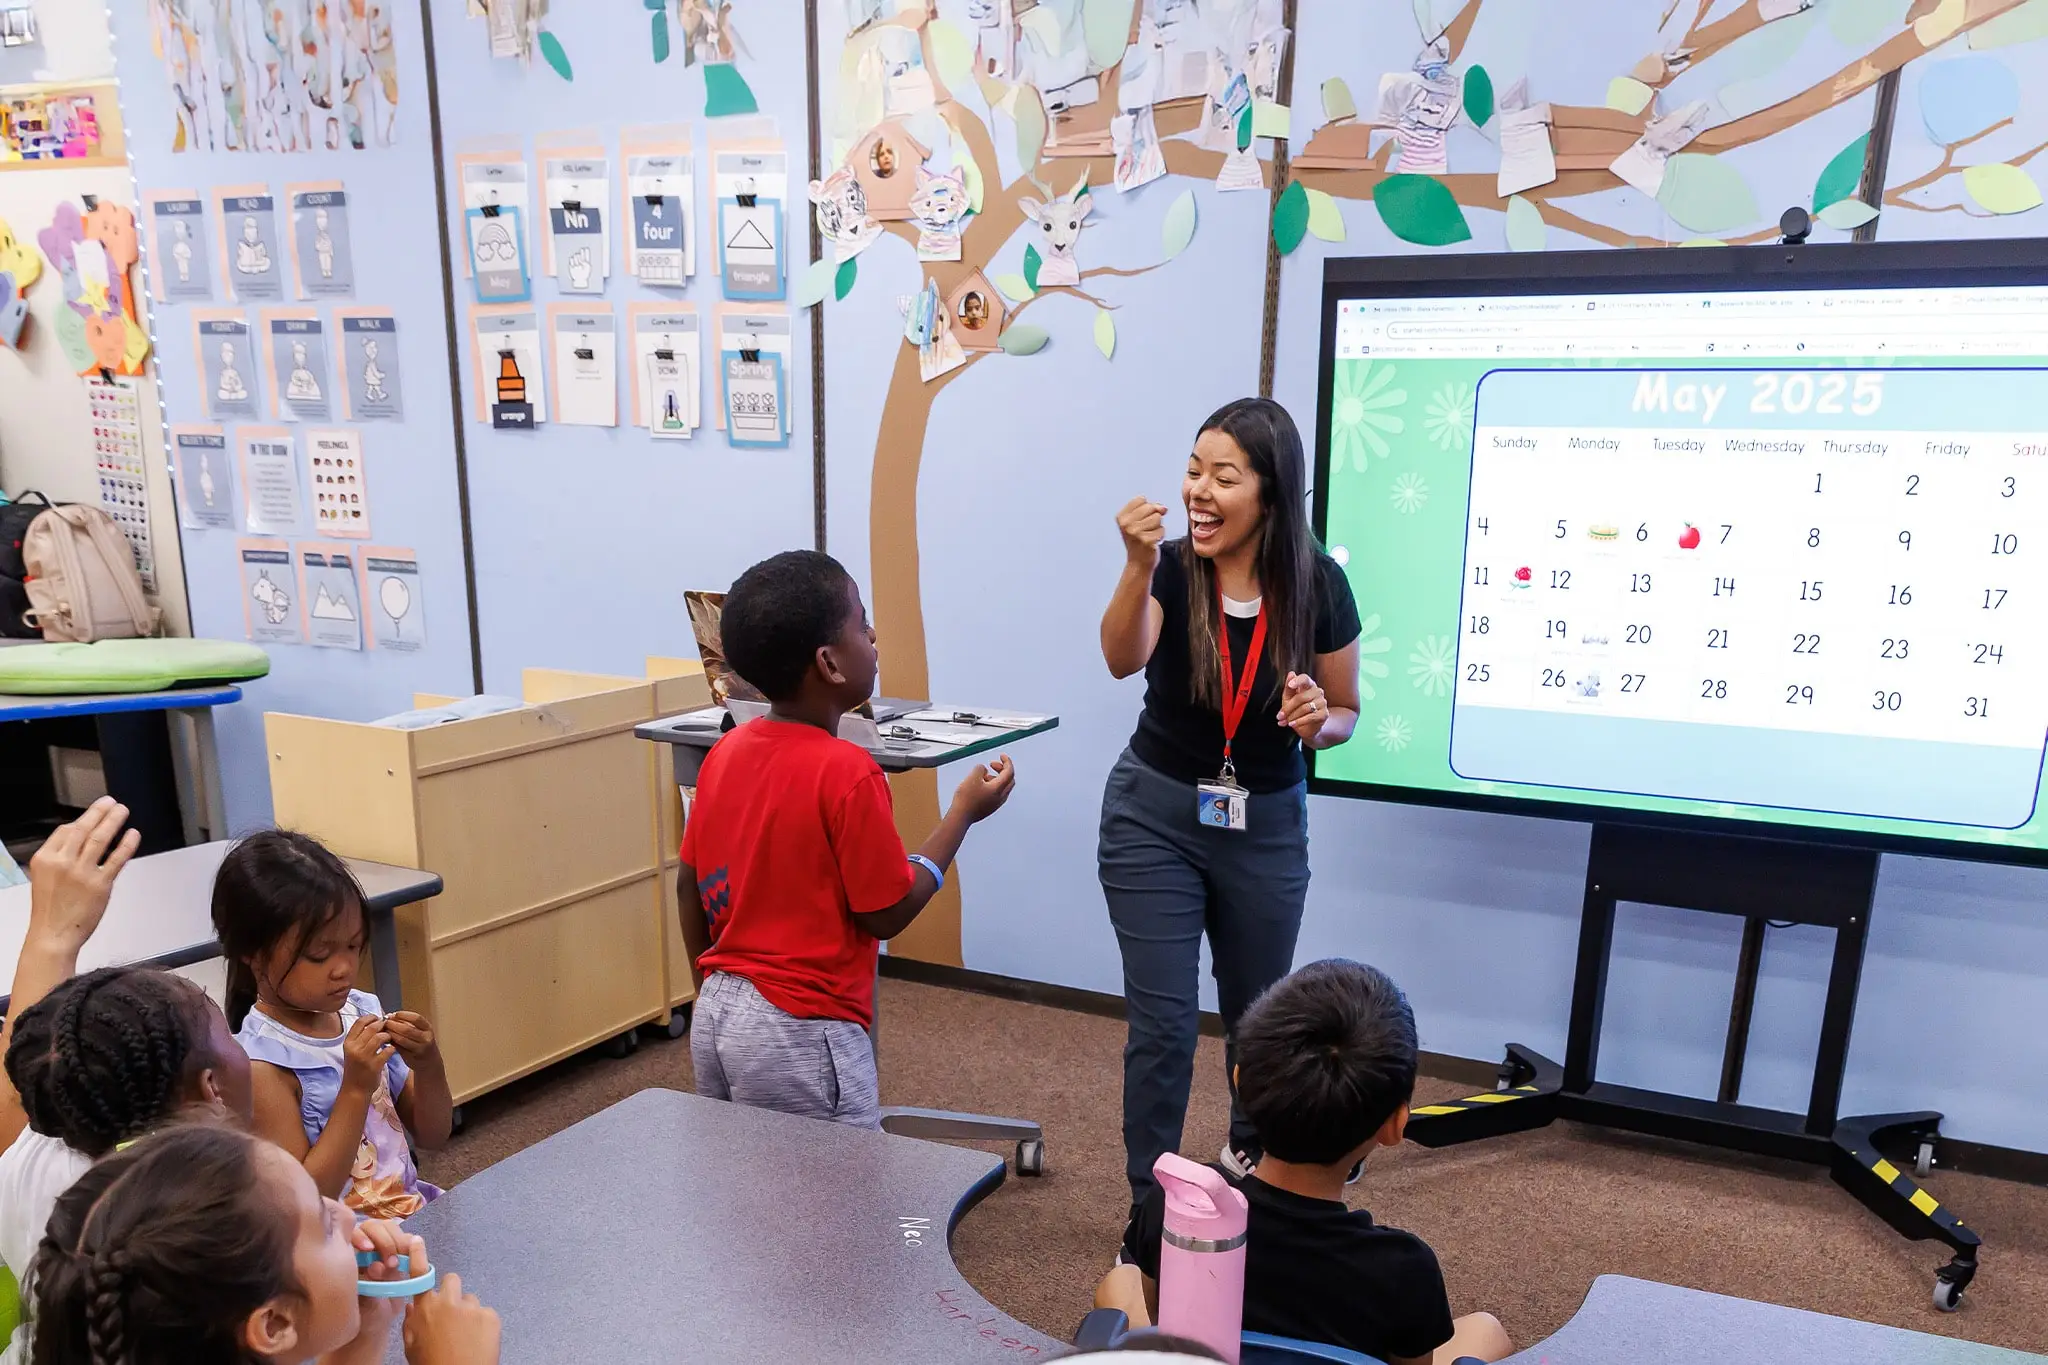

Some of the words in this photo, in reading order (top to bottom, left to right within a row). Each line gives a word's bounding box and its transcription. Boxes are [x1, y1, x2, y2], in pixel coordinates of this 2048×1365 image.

[563, 210, 589, 229] Nn
[652, 204, 663, 220] 4
[643, 221, 675, 241] four
[733, 270, 771, 286] triangle
[729, 361, 773, 379] Spring
[1631, 372, 1727, 424] May
[1750, 373, 1884, 416] 2025
[1492, 435, 1538, 451] Sunday
[1568, 437, 1621, 453] Monday
[1653, 437, 1706, 454] Tuesday
[1725, 439, 1806, 456] Wednesday
[1823, 439, 1889, 457] Thursday
[1925, 441, 1971, 459] Friday
[2012, 442, 2048, 457] Satu
[1814, 472, 1822, 494] 1
[1905, 474, 1920, 496] 2
[2001, 476, 2016, 498] 3
[1477, 516, 1489, 536] 4
[1554, 519, 1567, 539] 5
[1636, 522, 1649, 542] 6
[1720, 524, 1733, 545] 7
[1807, 527, 1821, 548] 8
[1898, 530, 1912, 552] 9
[1991, 533, 2018, 555] 10
[1473, 566, 1489, 586] 11
[1550, 570, 1572, 590] 12
[1630, 573, 1651, 594] 13
[1712, 577, 1736, 597] 14
[1799, 580, 1824, 602] 15
[1888, 584, 1912, 606] 16
[1981, 588, 2008, 610] 17
[1470, 615, 1490, 635] 18
[1545, 619, 1567, 639] 19
[1625, 624, 1652, 644] 20
[1707, 628, 1728, 649] 21
[1792, 633, 1821, 654] 22
[1880, 638, 1909, 660] 23
[1973, 643, 2004, 665] 24
[1466, 663, 1491, 683] 25
[1541, 668, 1566, 688] 26
[1620, 673, 1646, 693] 27
[1701, 678, 1727, 699] 28
[1785, 684, 1814, 705] 29
[1872, 690, 1902, 712] 30
[1963, 696, 1988, 718] 31
[898, 1216, 931, 1248] Neo
